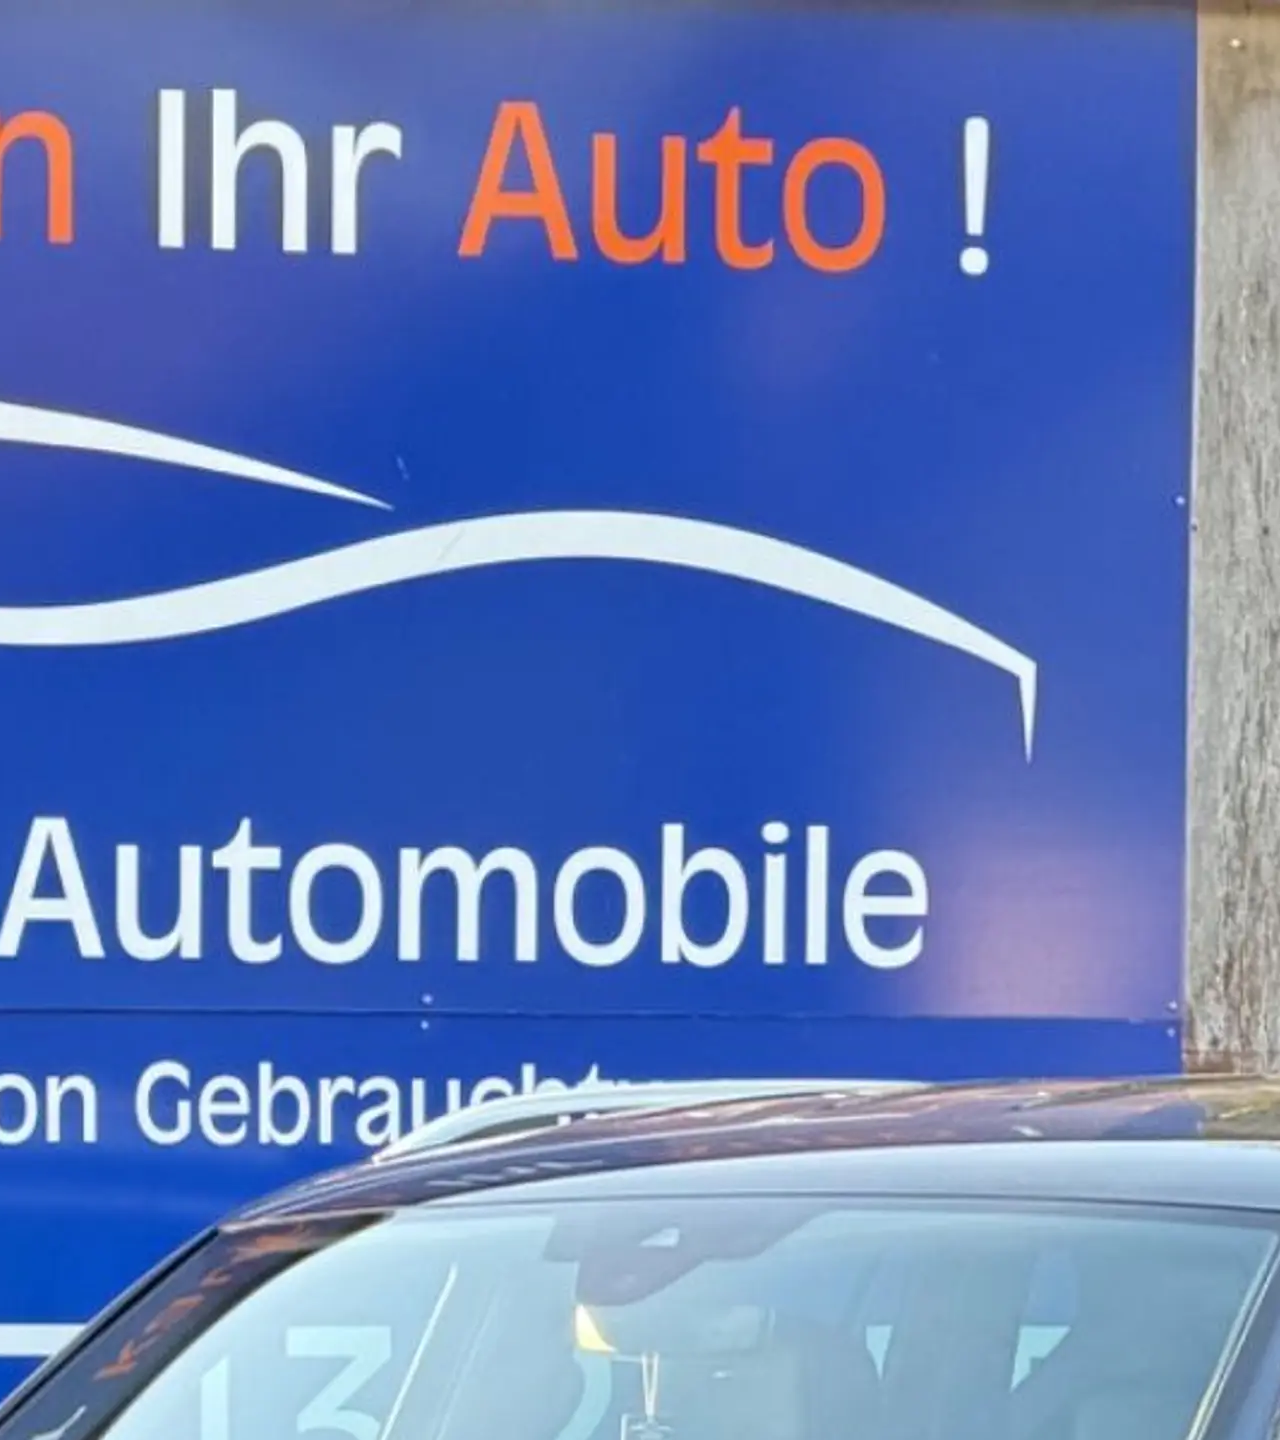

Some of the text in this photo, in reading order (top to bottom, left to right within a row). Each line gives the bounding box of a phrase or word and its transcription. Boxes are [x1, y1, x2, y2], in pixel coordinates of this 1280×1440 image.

[157, 88, 402, 255] Ihr
[458, 101, 886, 273] Auto
[960, 116, 989, 276] !
